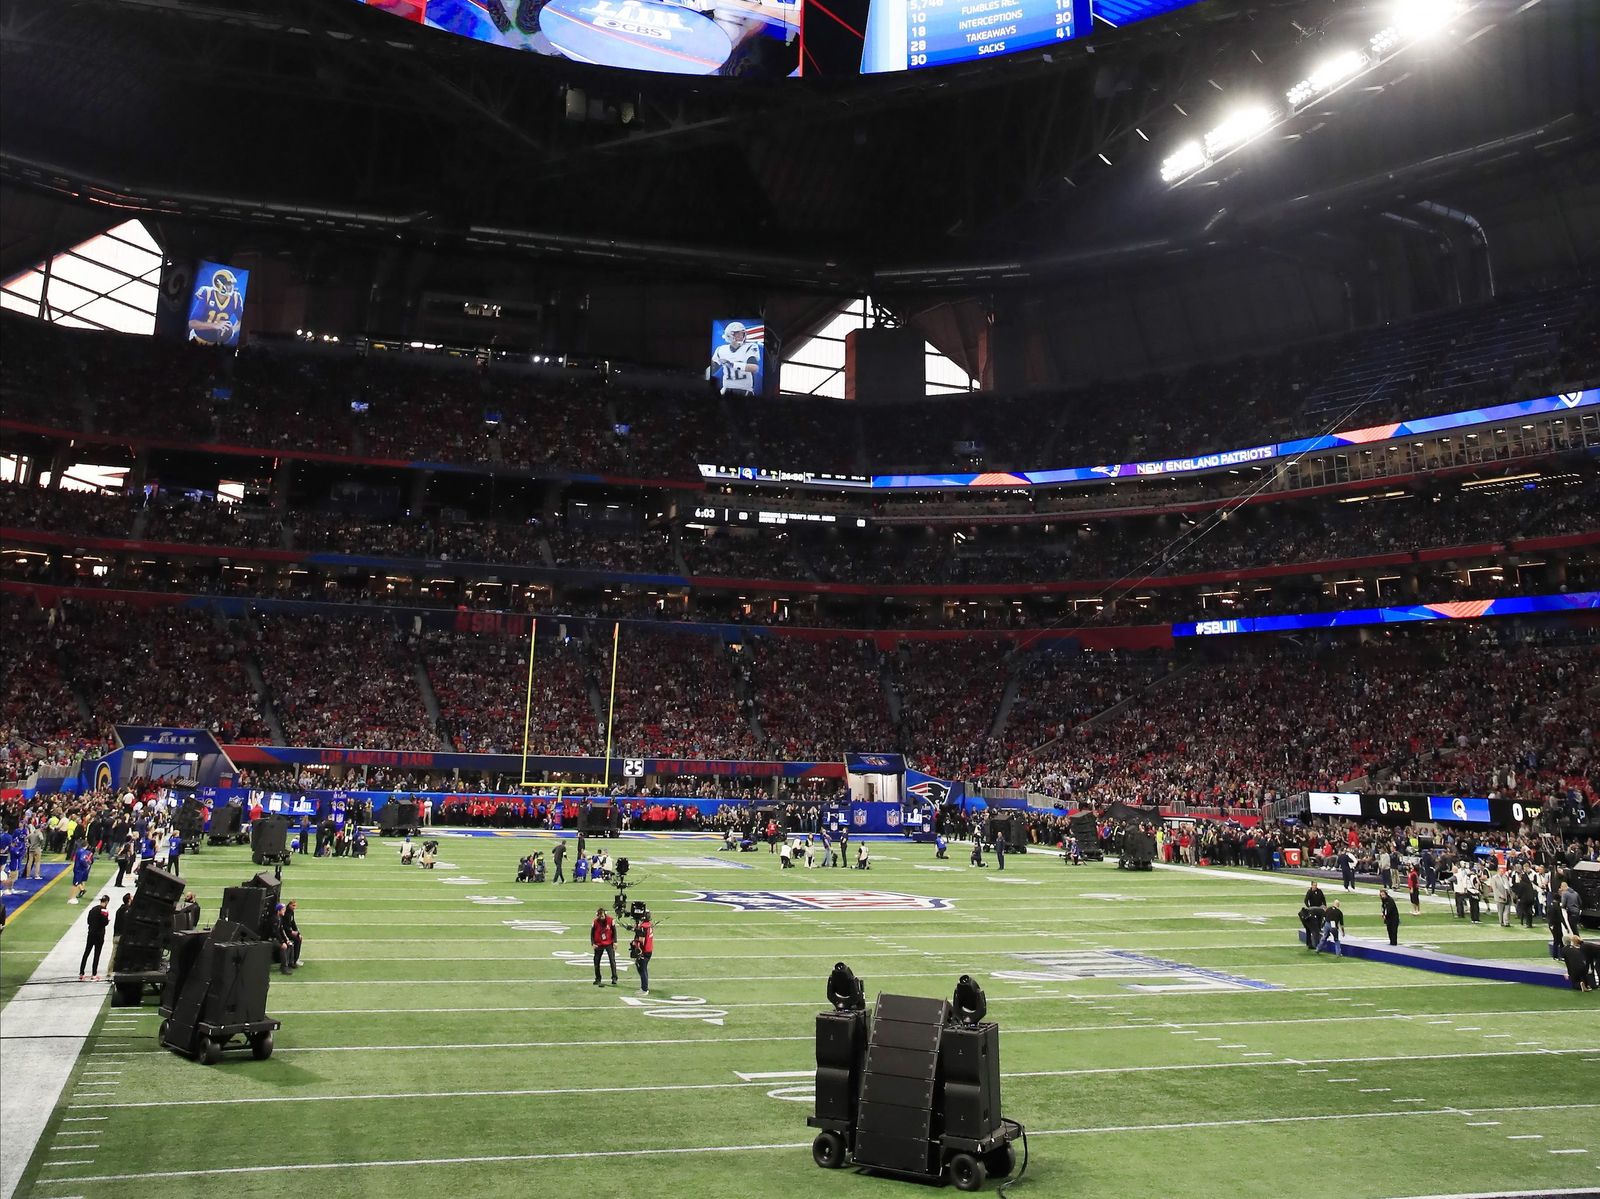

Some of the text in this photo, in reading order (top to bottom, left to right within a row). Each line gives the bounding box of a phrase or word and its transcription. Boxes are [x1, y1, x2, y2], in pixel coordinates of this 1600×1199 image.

[911, 12, 926, 23] 10
[961, 1, 1000, 15] FUMBLES
[911, 0, 1070, 37] 18 INTERCEPTIONS 18
[621, 23, 662, 38] CBS
[910, 12, 1071, 51] 28 TAKEAWAYS 30
[910, 26, 1071, 66] 30 SACKS 41
[1136, 447, 1272, 475] NEW ENGLAND PATRIOTS
[695, 508, 715, 518] 6:03
[1196, 620, 1238, 635] #SBLIII
[625, 760, 643, 775] 25
[1379, 798, 1410, 814] 0 TOL 3
[1512, 803, 1524, 822] 0
[1291, 853, 1298, 861] G
